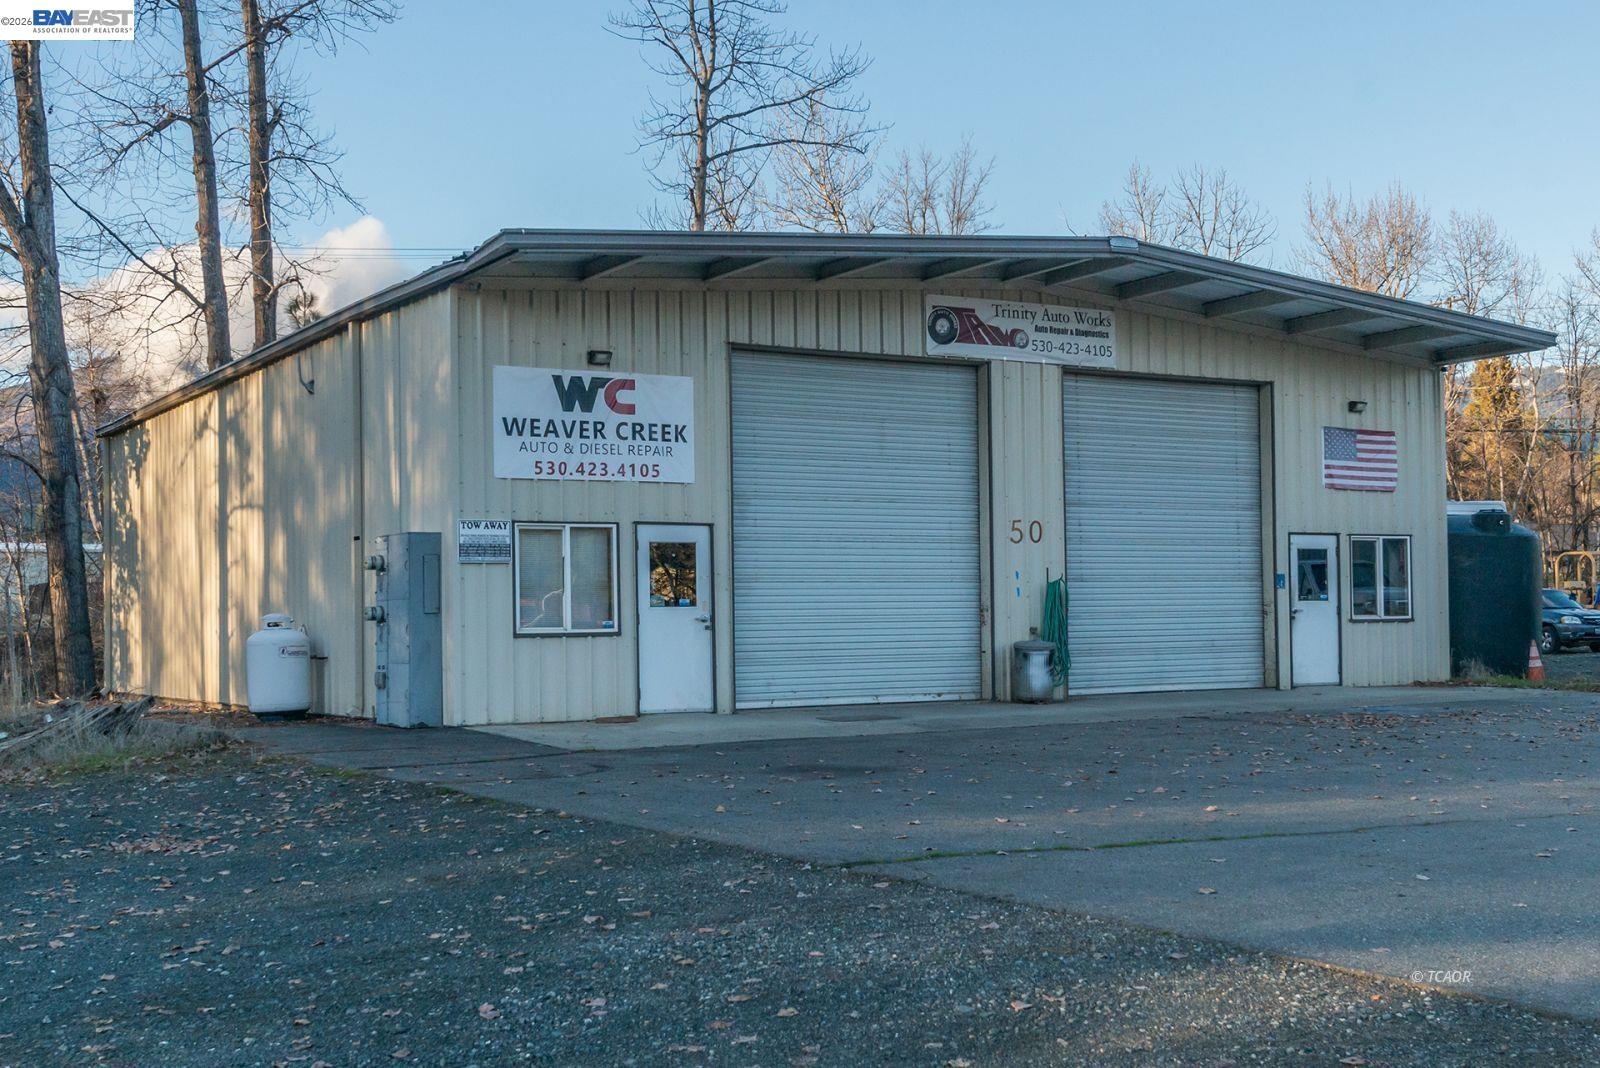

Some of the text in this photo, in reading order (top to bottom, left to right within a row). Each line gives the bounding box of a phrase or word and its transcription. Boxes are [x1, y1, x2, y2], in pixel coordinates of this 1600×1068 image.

[991, 304, 1112, 328] Trinity Auto Works
[1034, 324, 1049, 334] Auto
[1049, 325, 1069, 336] Repair
[1075, 328, 1110, 339] Diagnostics
[1031, 339, 1113, 358] 530-423-4105
[551, 374, 636, 415] WC
[502, 416, 688, 443] WEAVER CREEK
[519, 441, 674, 457] AUTO & DIESEL REPAIR
[534, 460, 661, 478] 530.423.4105
[460, 521, 508, 530] TOW AWAY
[1010, 519, 1042, 544] 50
